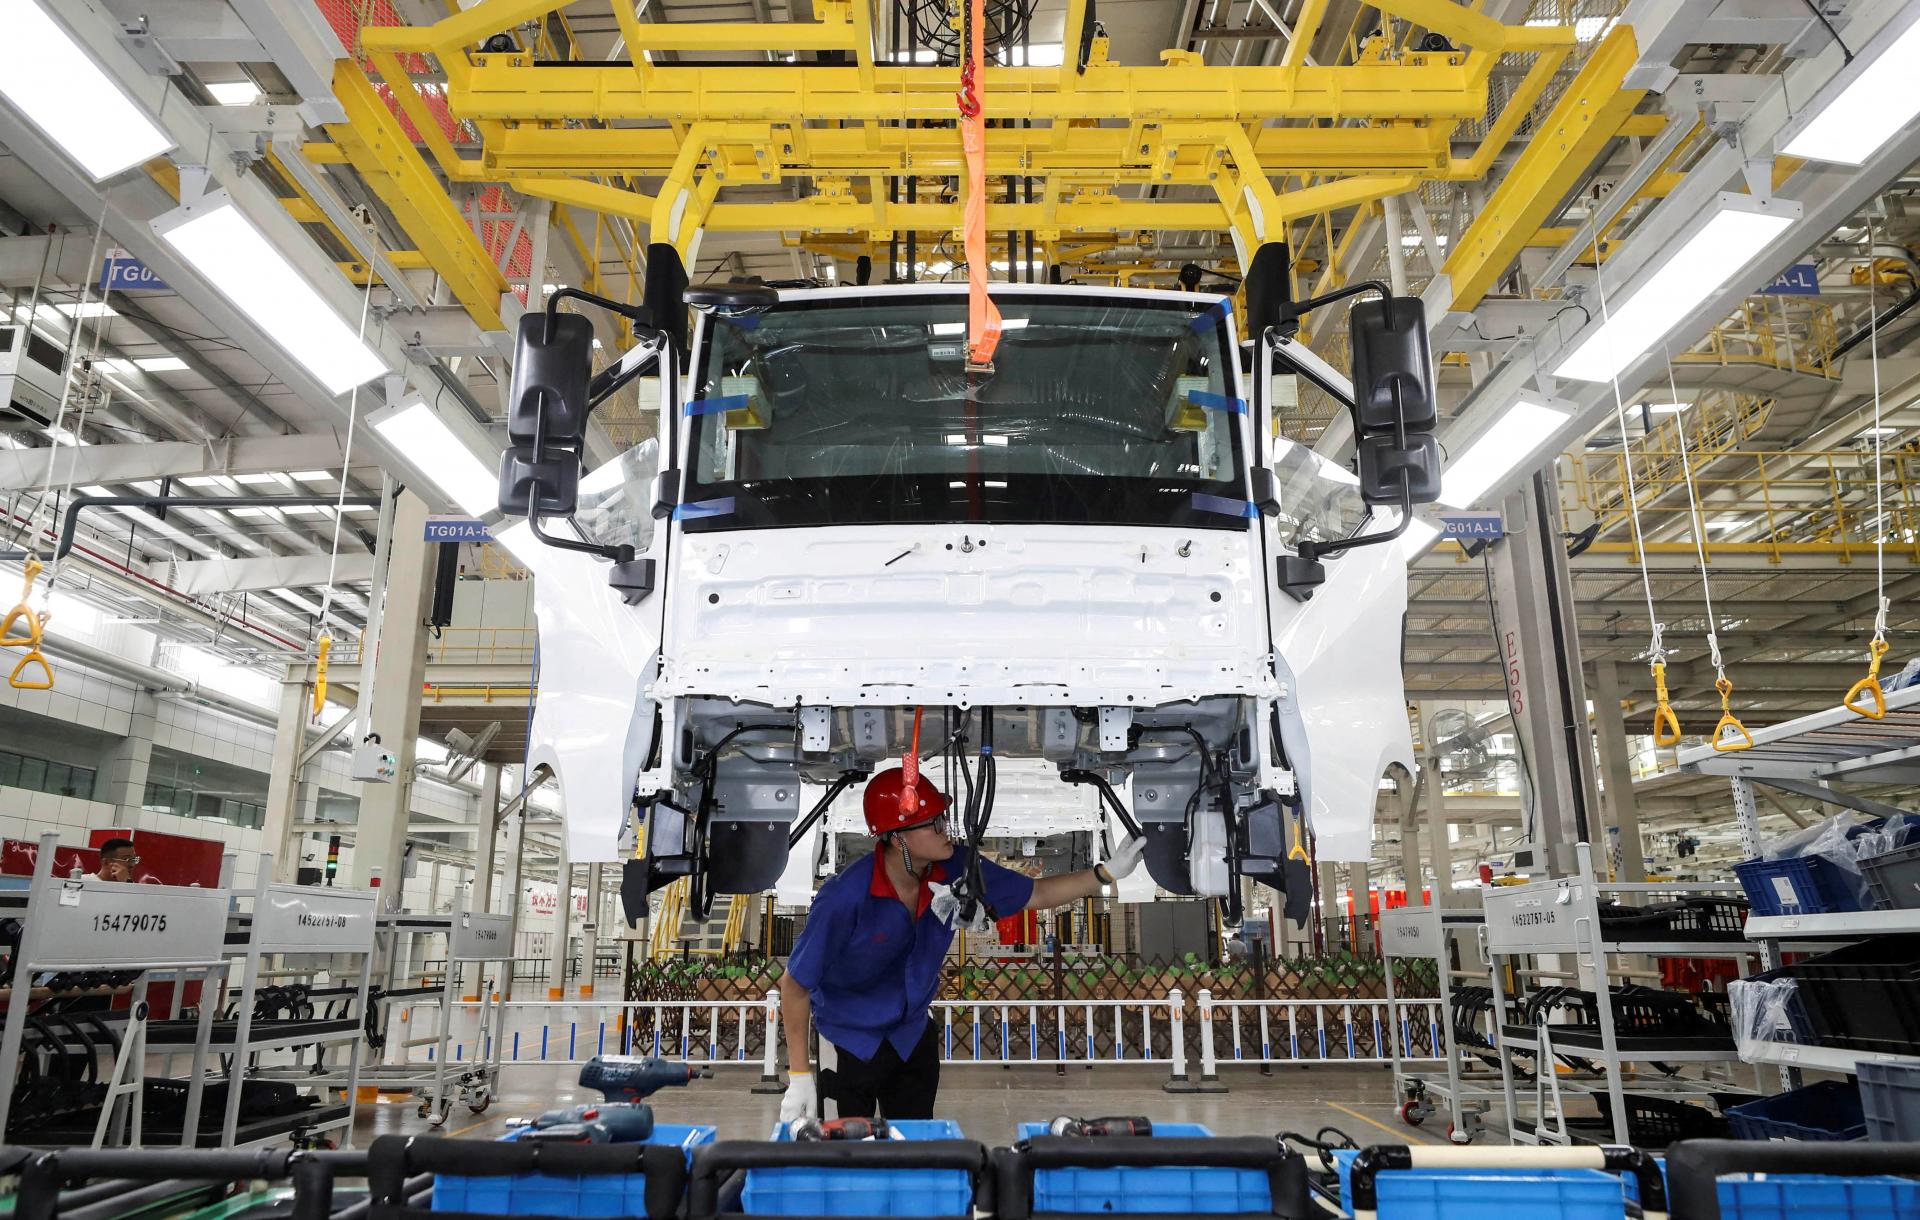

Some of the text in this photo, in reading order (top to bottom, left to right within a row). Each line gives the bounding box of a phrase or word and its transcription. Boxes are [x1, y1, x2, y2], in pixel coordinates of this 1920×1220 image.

[112, 265, 161, 281] TG0
[1445, 522, 1499, 533] G01A-L
[93, 914, 167, 932] 15479075
[1511, 911, 1556, 927] 14522757-05
